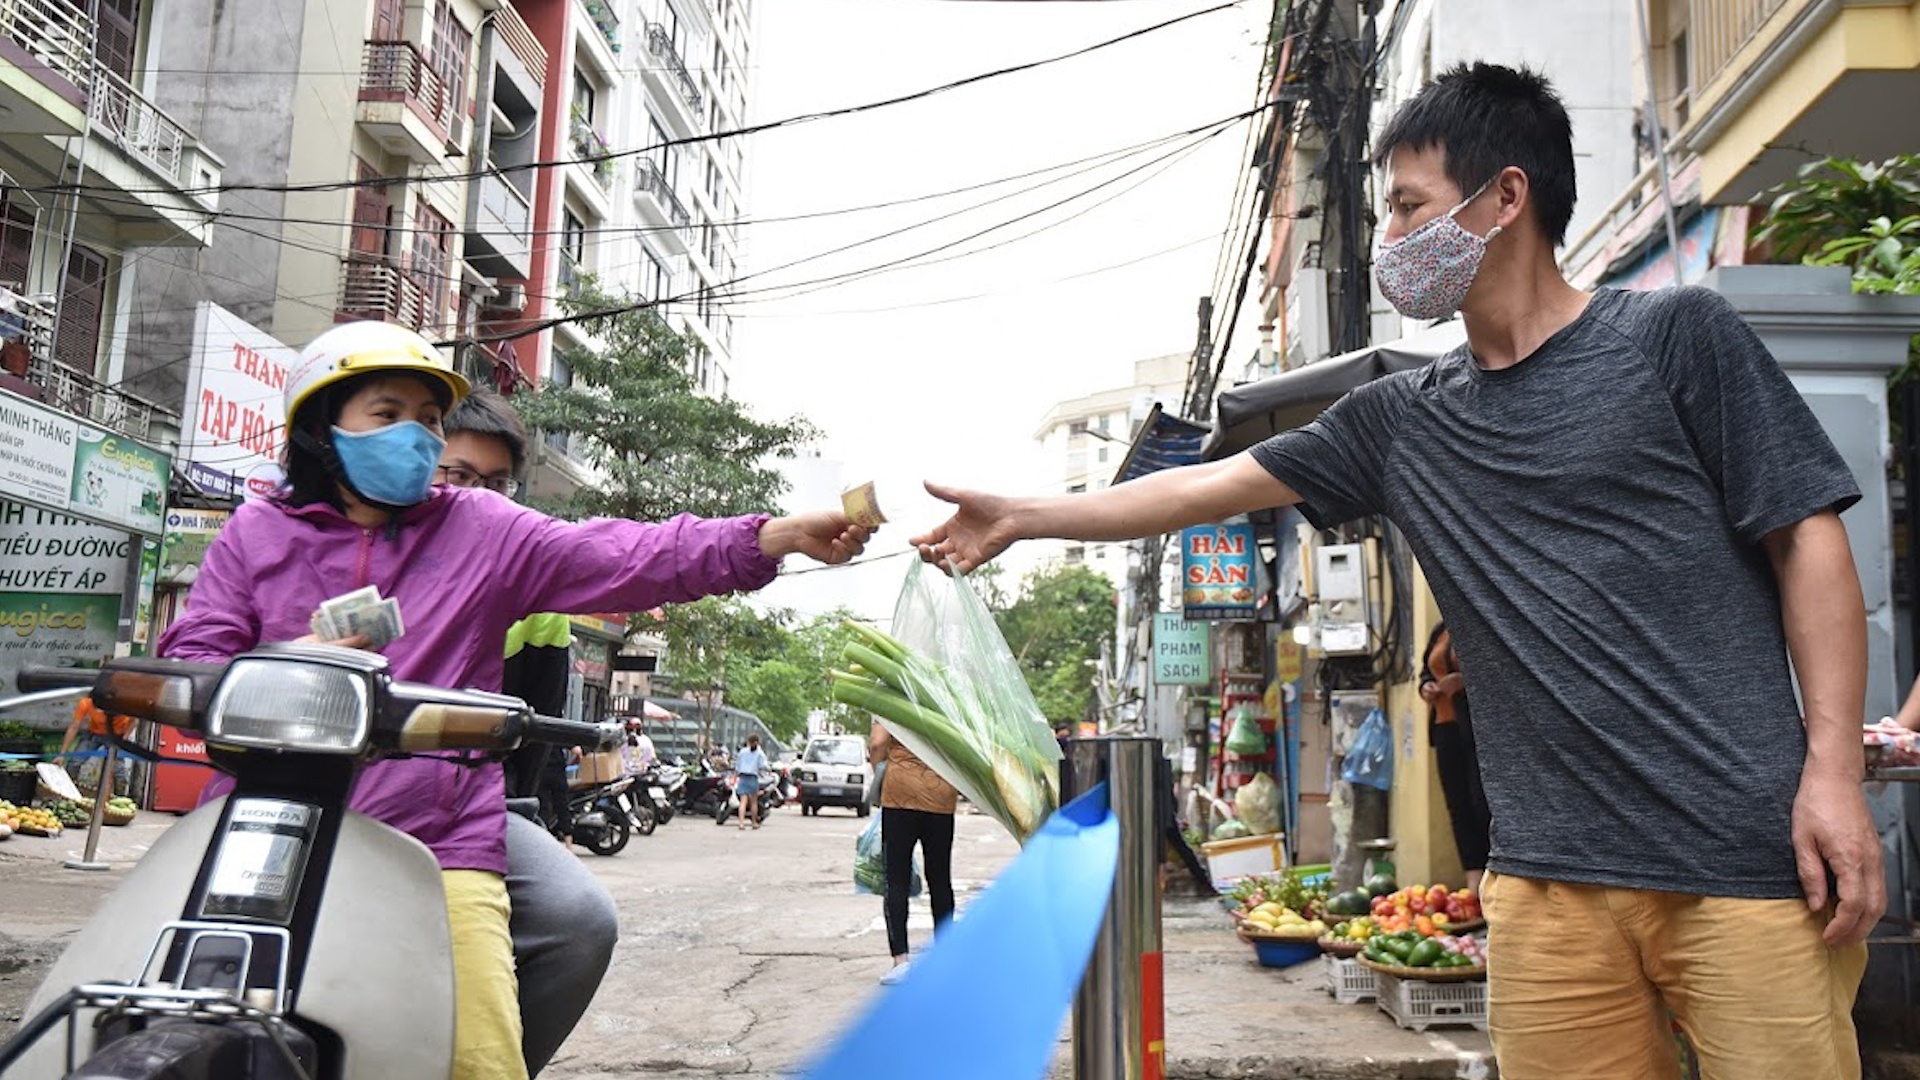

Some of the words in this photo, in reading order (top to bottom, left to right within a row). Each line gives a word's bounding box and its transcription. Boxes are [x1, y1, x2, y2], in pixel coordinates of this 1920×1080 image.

[233, 342, 289, 391] THAN
[0, 406, 30, 431] MINH
[200, 388, 238, 447] TẠP
[239, 402, 275, 460] HÓA
[101, 438, 154, 472] Eugica
[45, 535, 129, 558] ĐƯỜNG
[1191, 527, 1245, 554] HẢI
[74, 567, 107, 589] ÁP
[1188, 558, 1248, 584] SẢN
[1162, 664, 1201, 677] SACH
[241, 809, 301, 821] HONDA
[241, 869, 286, 882] Dream
